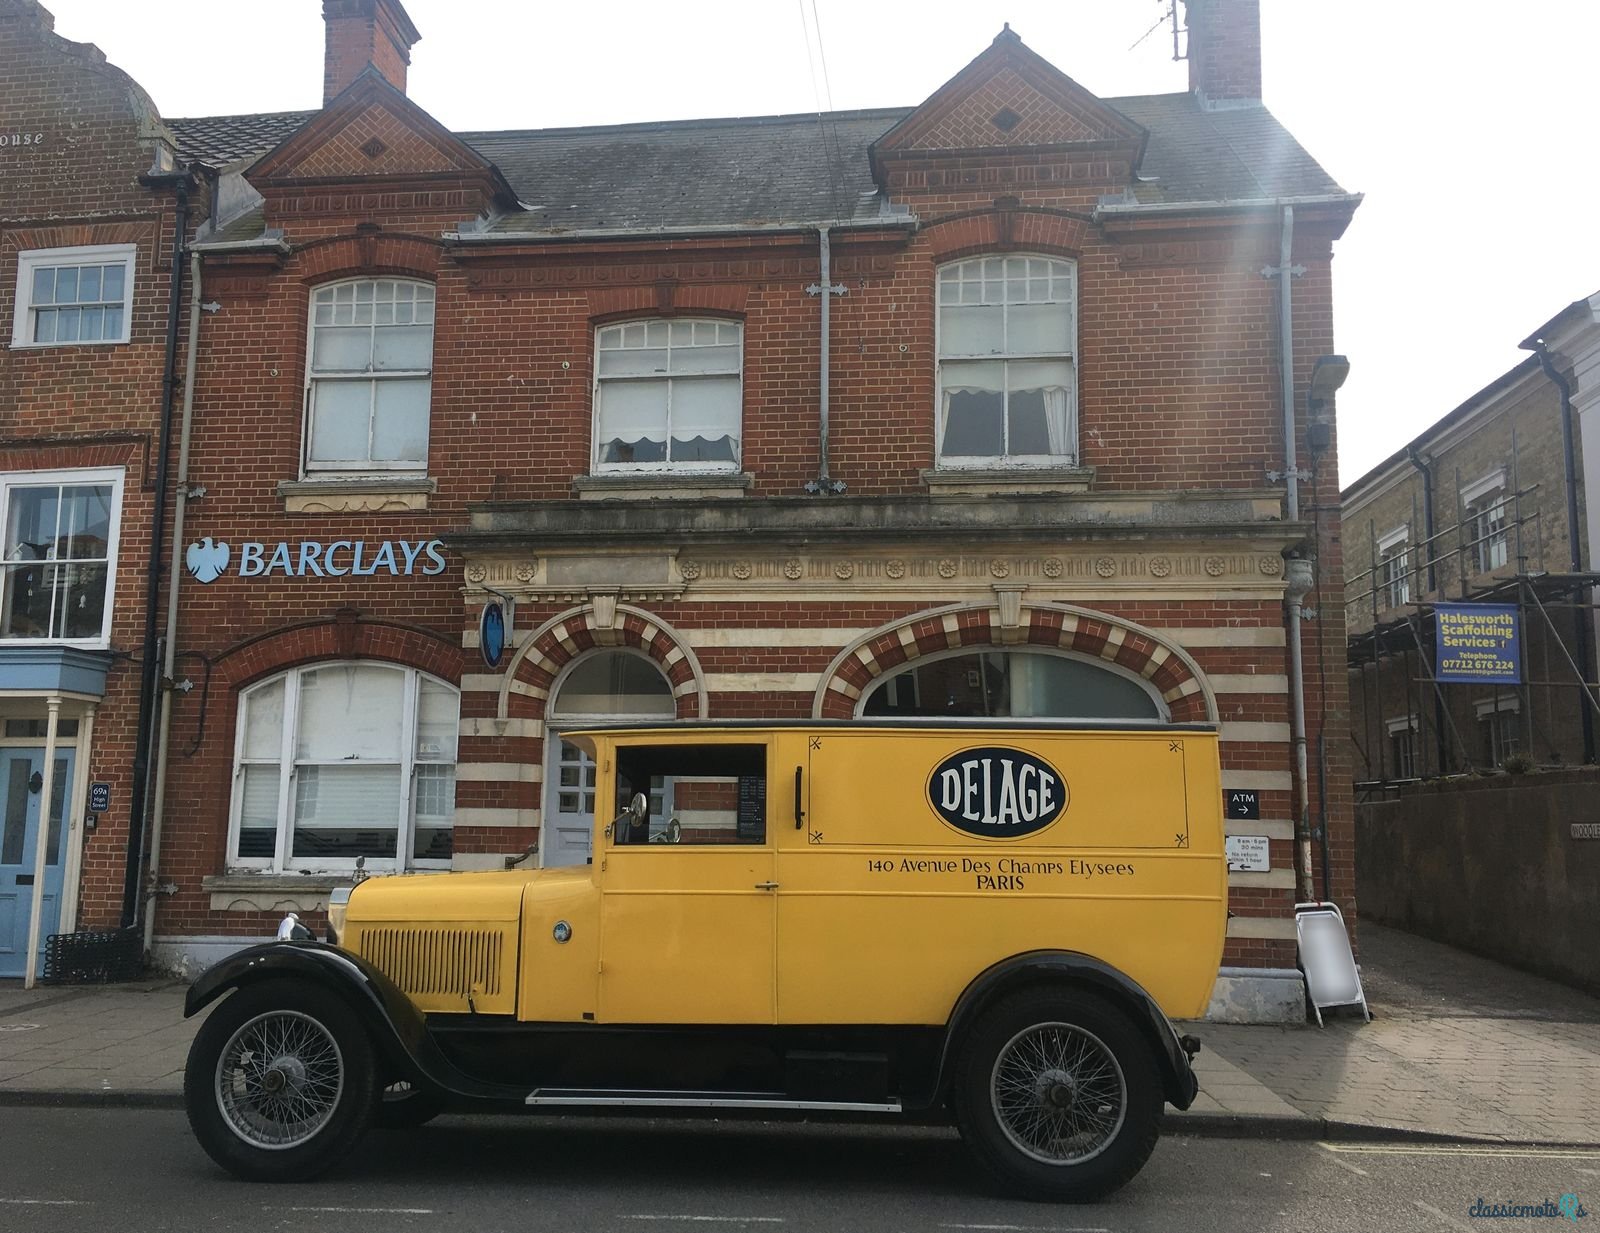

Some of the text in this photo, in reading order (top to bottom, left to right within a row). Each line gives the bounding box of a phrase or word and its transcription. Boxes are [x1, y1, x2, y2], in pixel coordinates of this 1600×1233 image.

[238, 539, 447, 577] BARCLAYS
[1439, 613, 1513, 625] Halesworth
[1441, 625, 1513, 639] Scaffolding
[1443, 636, 1496, 648] Services
[1459, 652, 1497, 660] Telephone
[1442, 660, 1514, 670] 07712 676 224
[940, 758, 1056, 825] DELAGE
[1232, 794, 1255, 803] ATM
[868, 858, 1135, 879] 140 Avenue Des Champs Elysees
[976, 875, 1024, 890] PARIS
